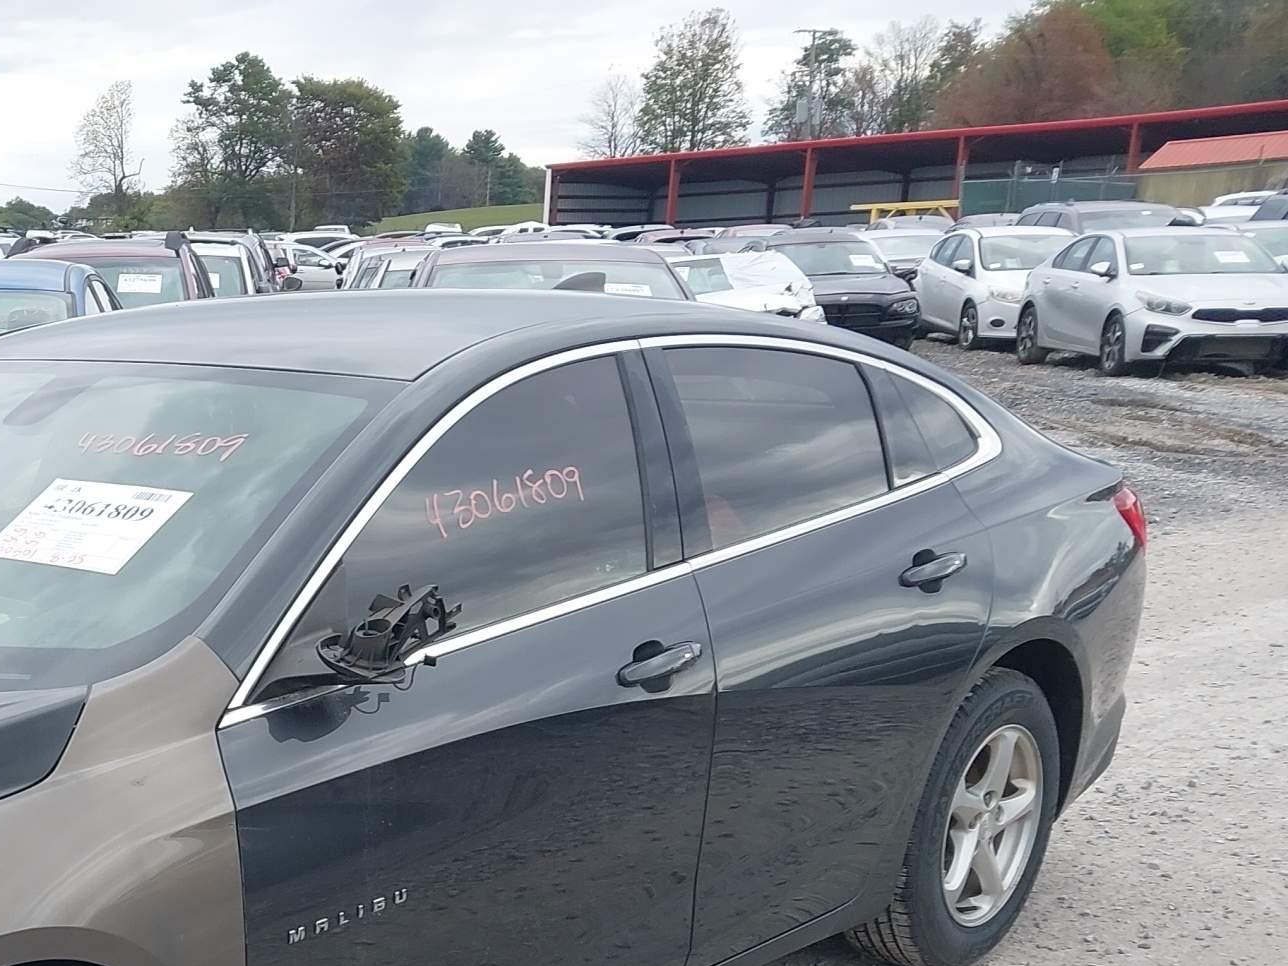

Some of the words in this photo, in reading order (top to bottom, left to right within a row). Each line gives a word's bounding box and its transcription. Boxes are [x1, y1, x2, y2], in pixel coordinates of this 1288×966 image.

[78, 431, 249, 462] 43061809
[425, 465, 585, 538] 43061809
[288, 888, 408, 945] MALIBU
